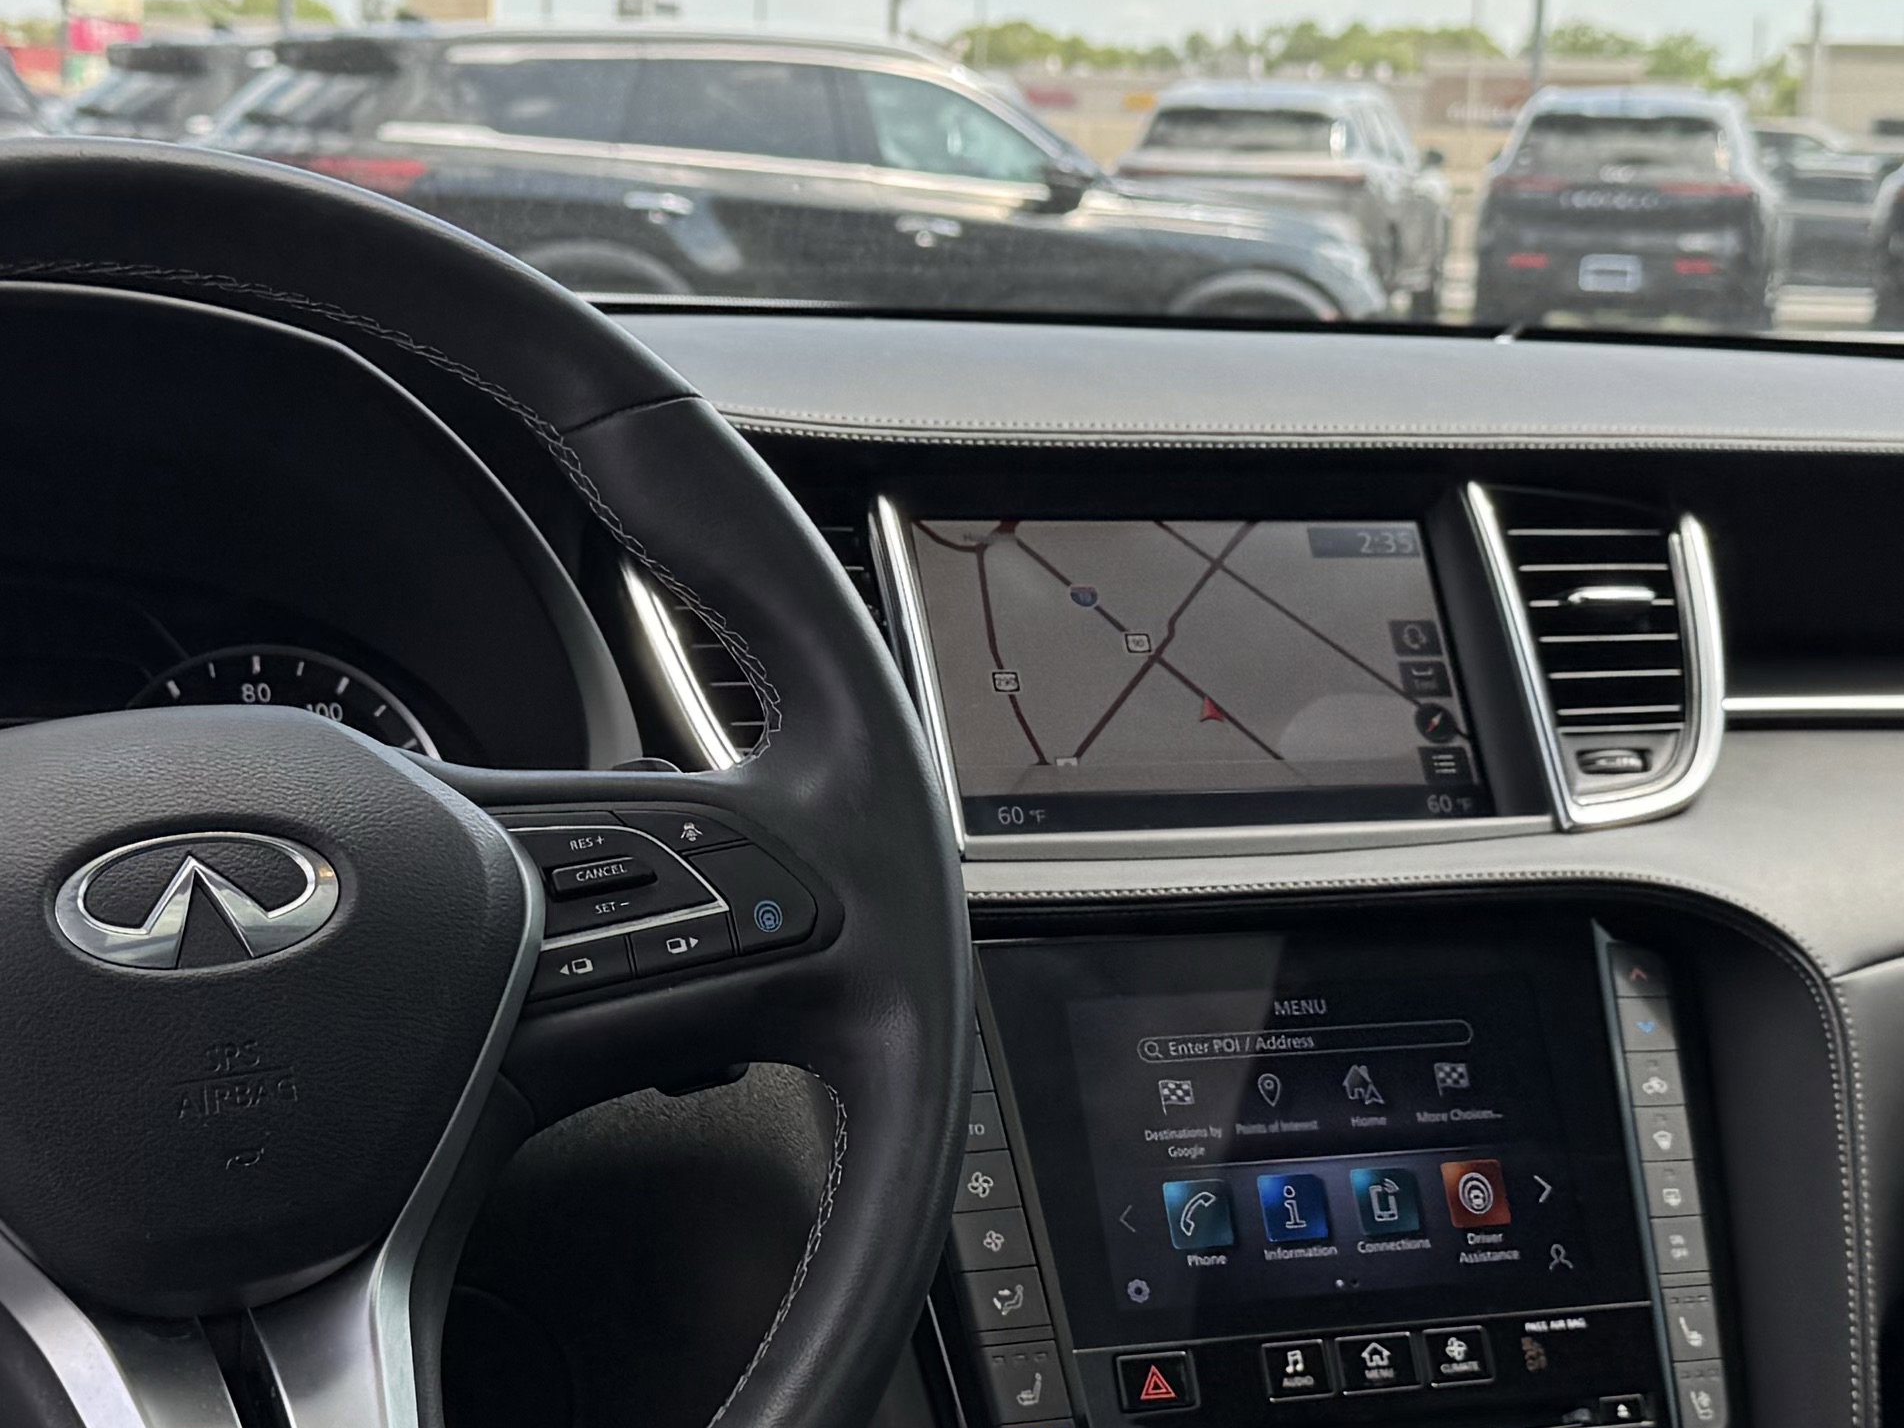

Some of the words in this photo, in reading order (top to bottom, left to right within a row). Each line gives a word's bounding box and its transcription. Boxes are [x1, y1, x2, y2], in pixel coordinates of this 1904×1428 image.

[1357, 532, 1414, 554] 2:35
[241, 683, 271, 703] 80
[1426, 794, 1453, 813] 60
[998, 806, 1024, 825] 60
[576, 863, 628, 882] CANCEL
[595, 901, 616, 914] SET
[1273, 999, 1327, 1016] MENU
[1168, 1039, 1209, 1057] Enter
[1212, 1038, 1241, 1053] POI
[1255, 1034, 1315, 1051] Address
[1351, 1114, 1387, 1128] Home
[1144, 1127, 1207, 1142] Destinations
[1208, 1125, 1222, 1141] by
[1168, 1144, 1205, 1159] Google
[1357, 1236, 1431, 1254] Connections
[1467, 1231, 1503, 1245] Driver
[1187, 1252, 1227, 1267] Phone
[1264, 1243, 1338, 1260] Information
[1459, 1247, 1520, 1263] Assistance
[1282, 1375, 1314, 1388] AUDIO
